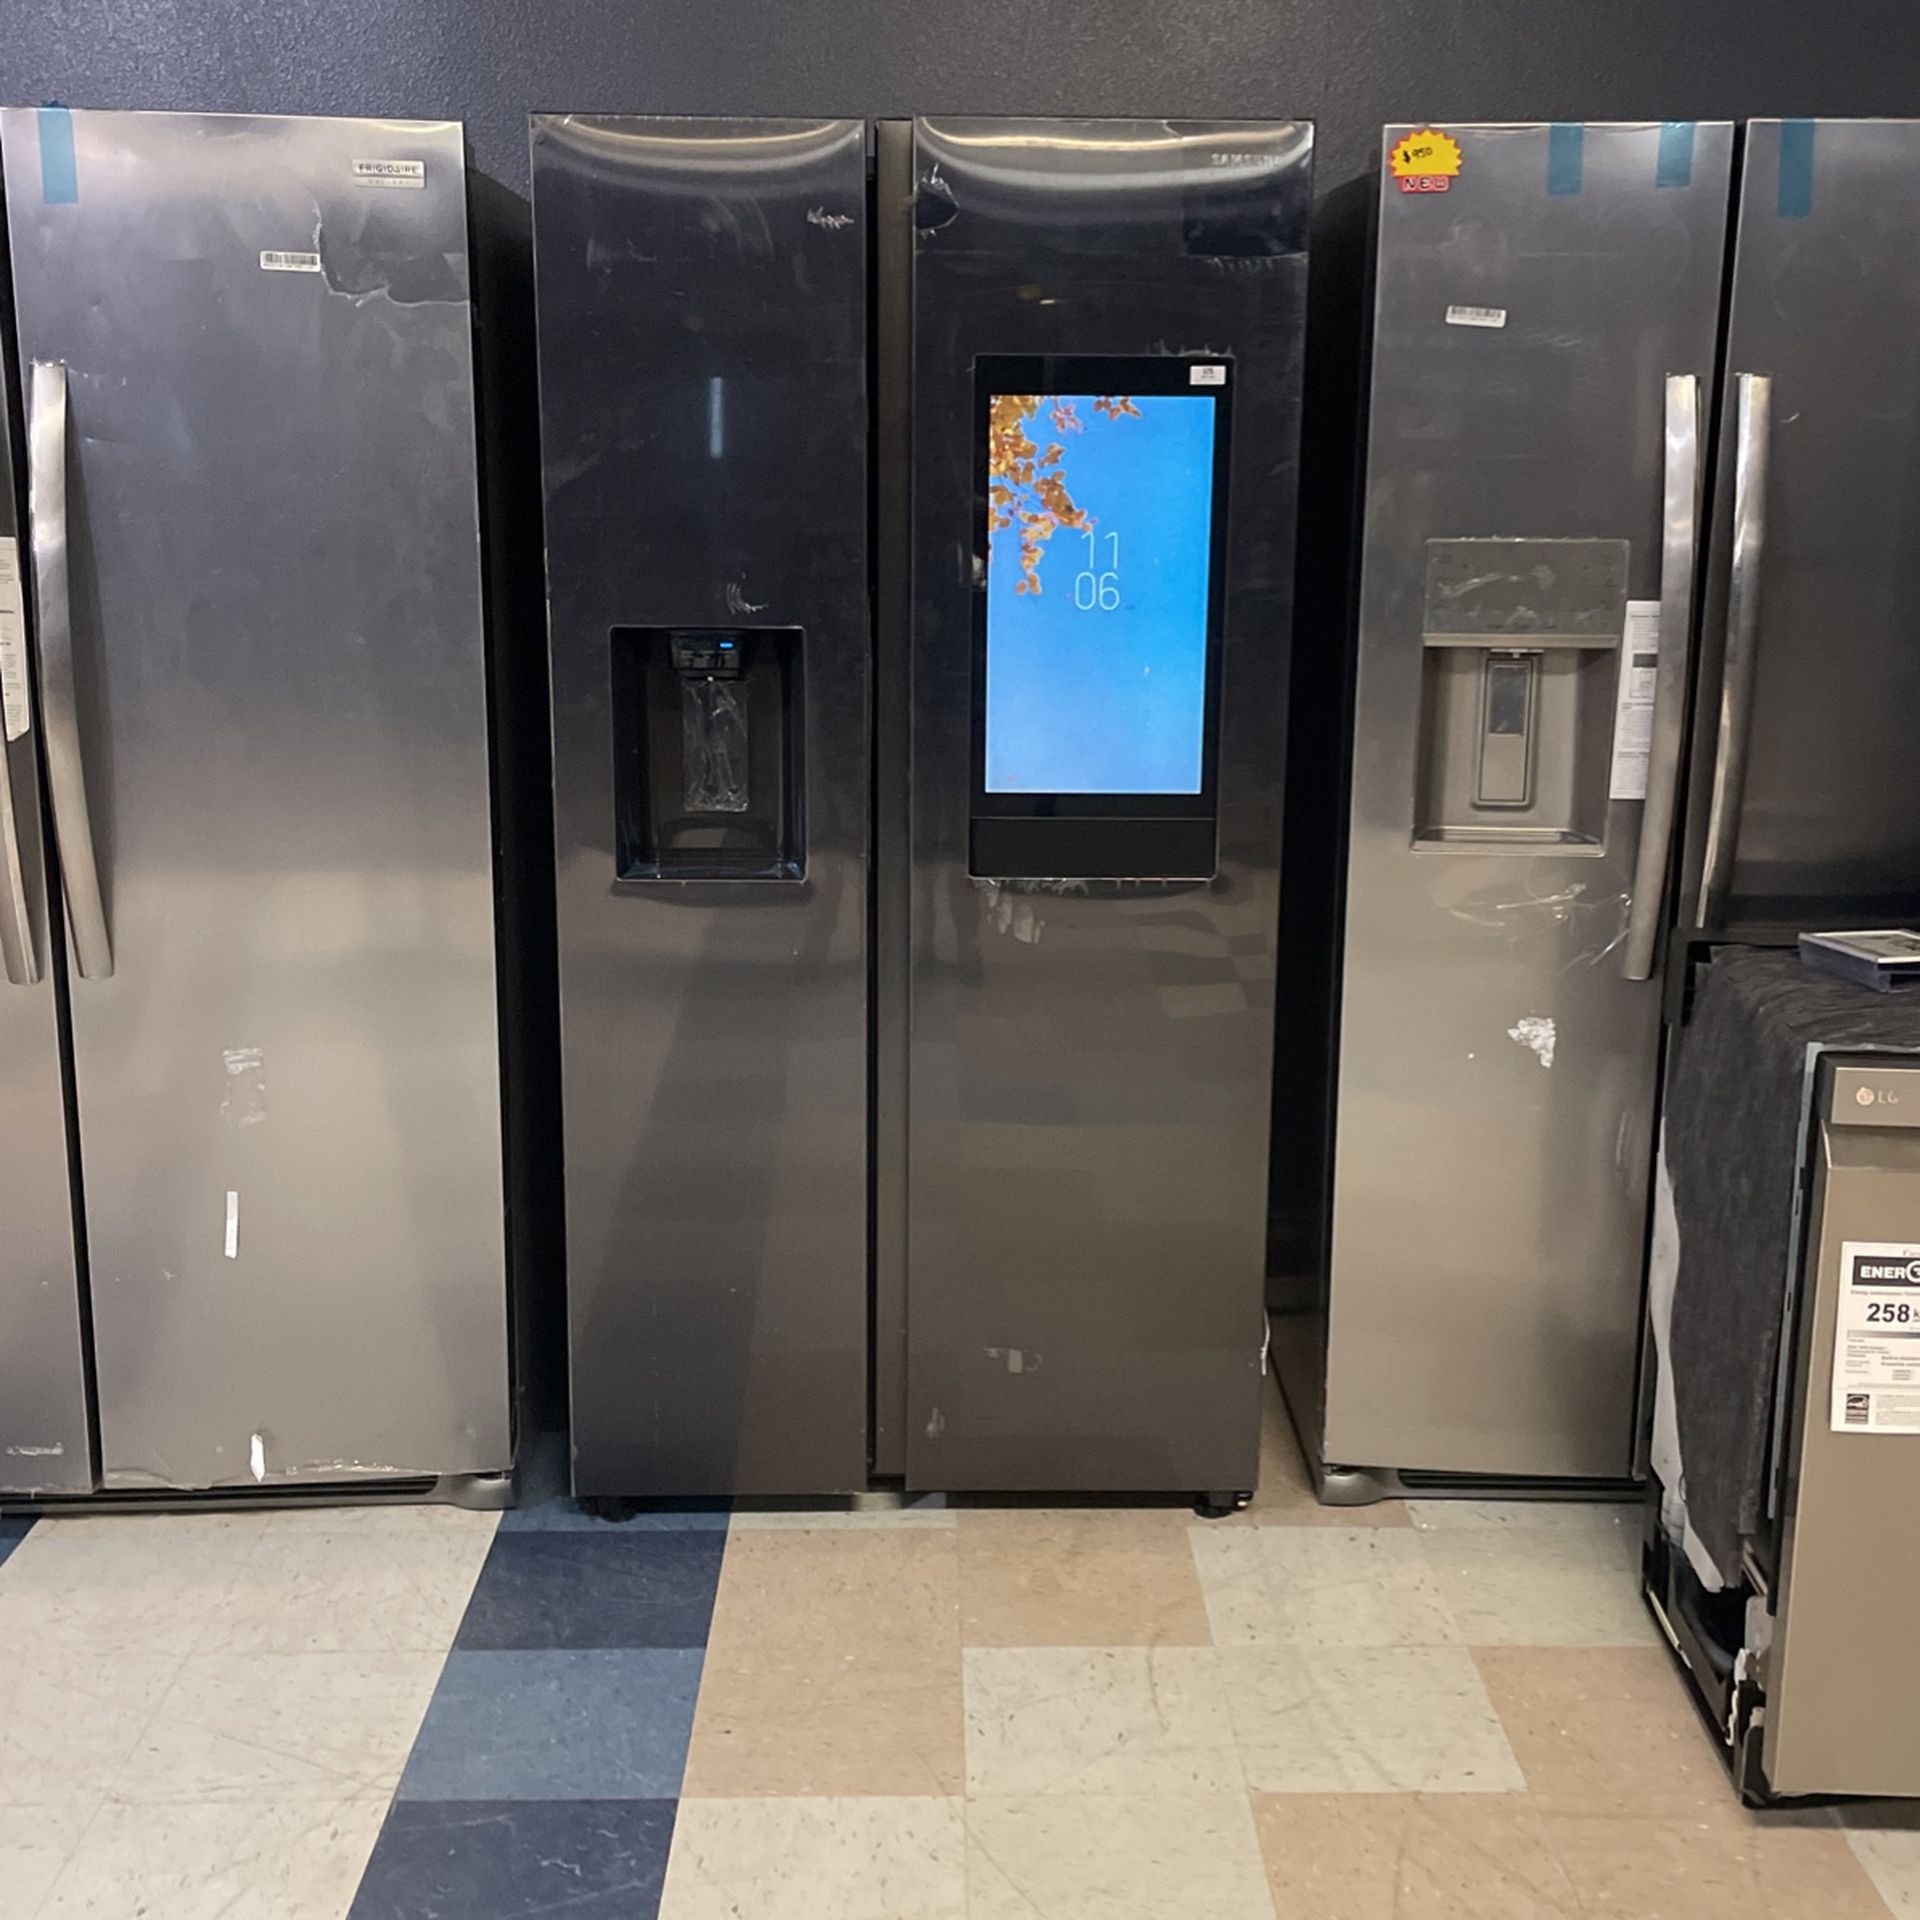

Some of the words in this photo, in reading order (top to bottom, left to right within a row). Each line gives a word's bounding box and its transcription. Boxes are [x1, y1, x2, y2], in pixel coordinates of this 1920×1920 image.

[359, 163, 416, 174] FRIGIDAIRE
[1405, 176, 1446, 190] NEW
[1081, 531, 1118, 570] 11
[1075, 571, 1120, 611] 06
[1878, 1090, 1899, 1104] LG
[1866, 1302, 1910, 1323] 258
